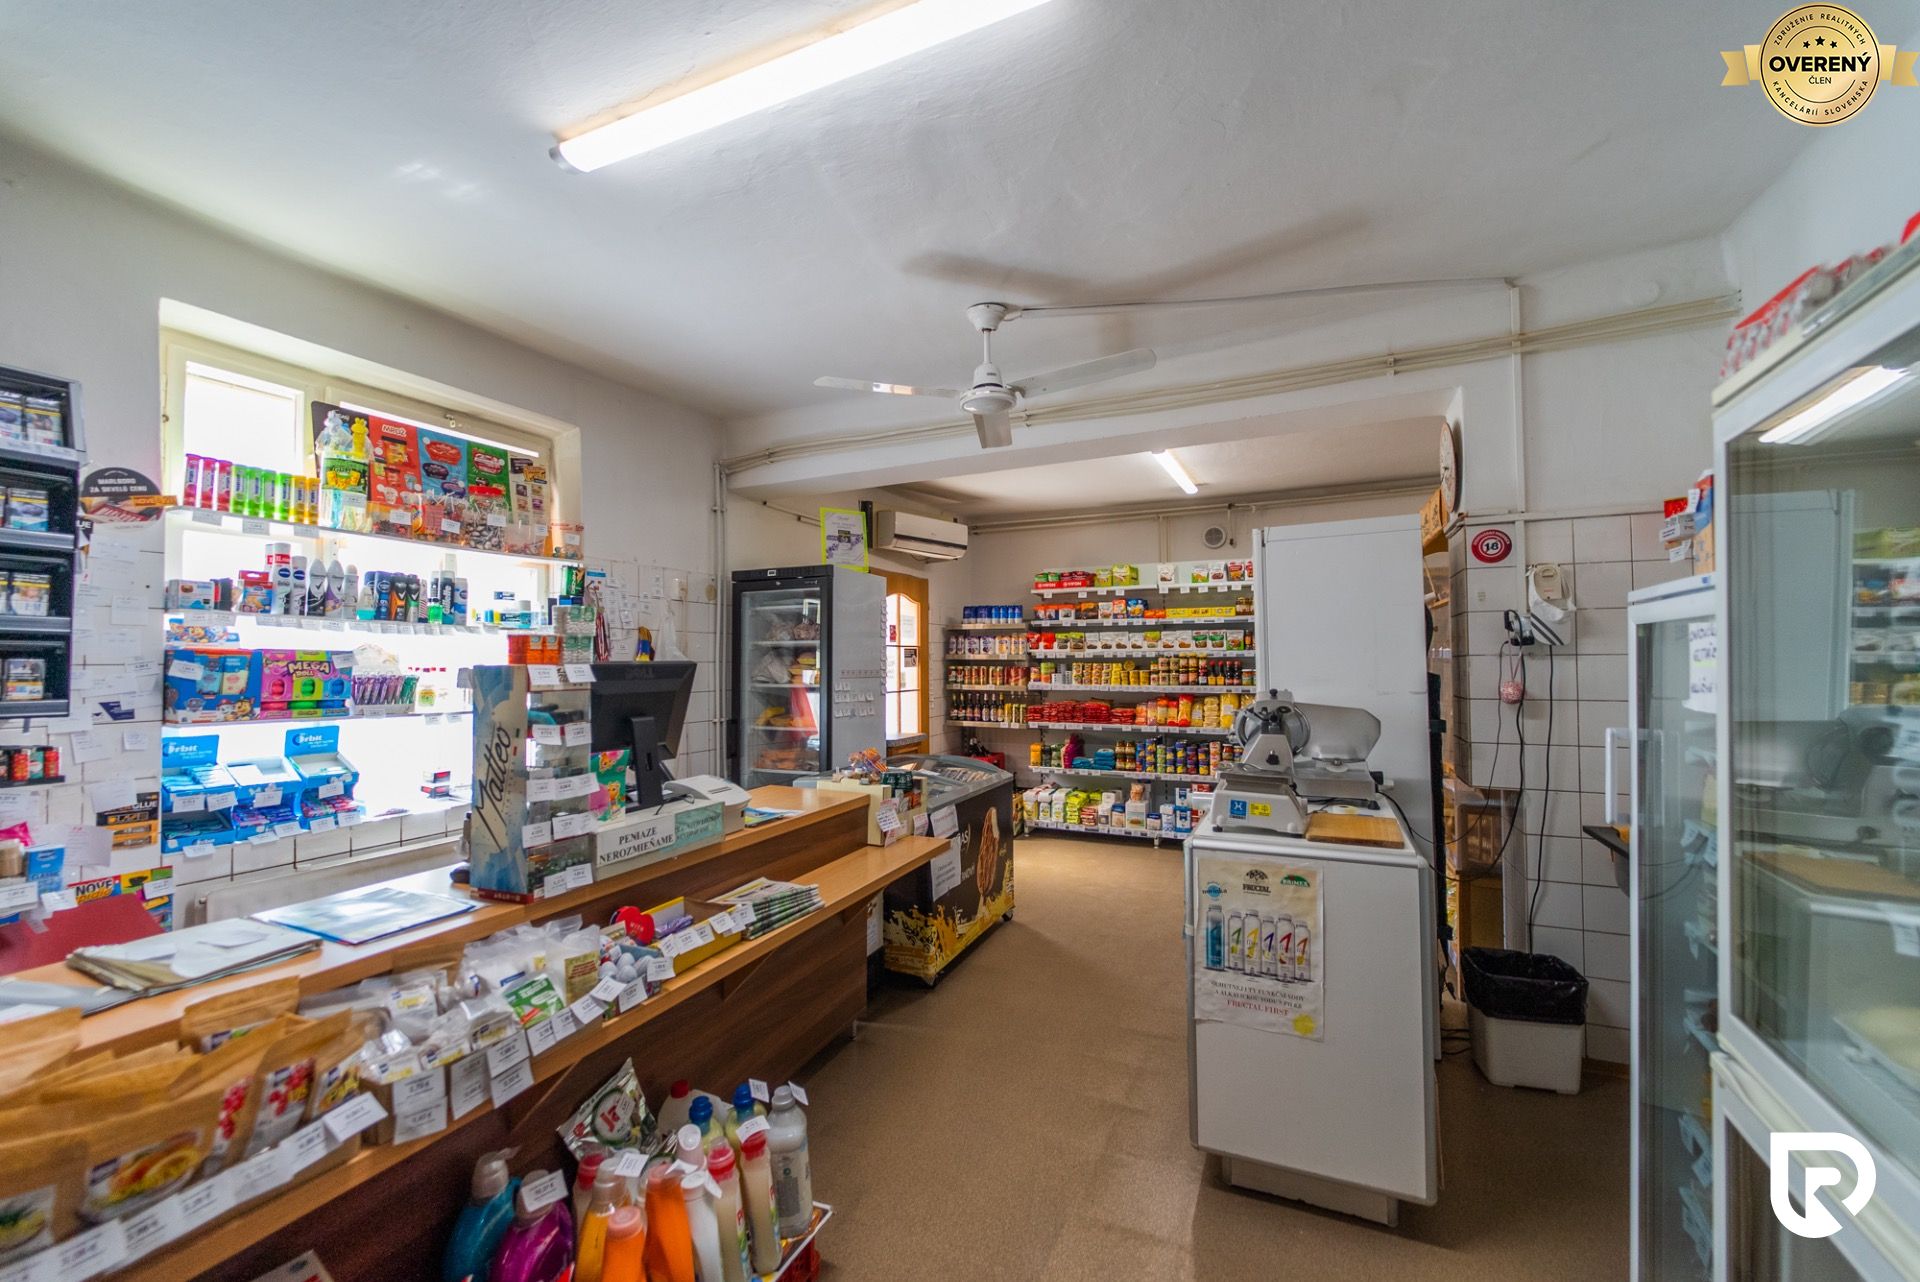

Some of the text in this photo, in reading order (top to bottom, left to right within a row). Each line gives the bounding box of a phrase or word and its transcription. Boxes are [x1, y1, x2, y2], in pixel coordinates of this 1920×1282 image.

[287, 661, 331, 675] MEGA
[619, 827, 657, 845] PENIAZE
[600, 834, 674, 864] NEROZMIEŇAME
